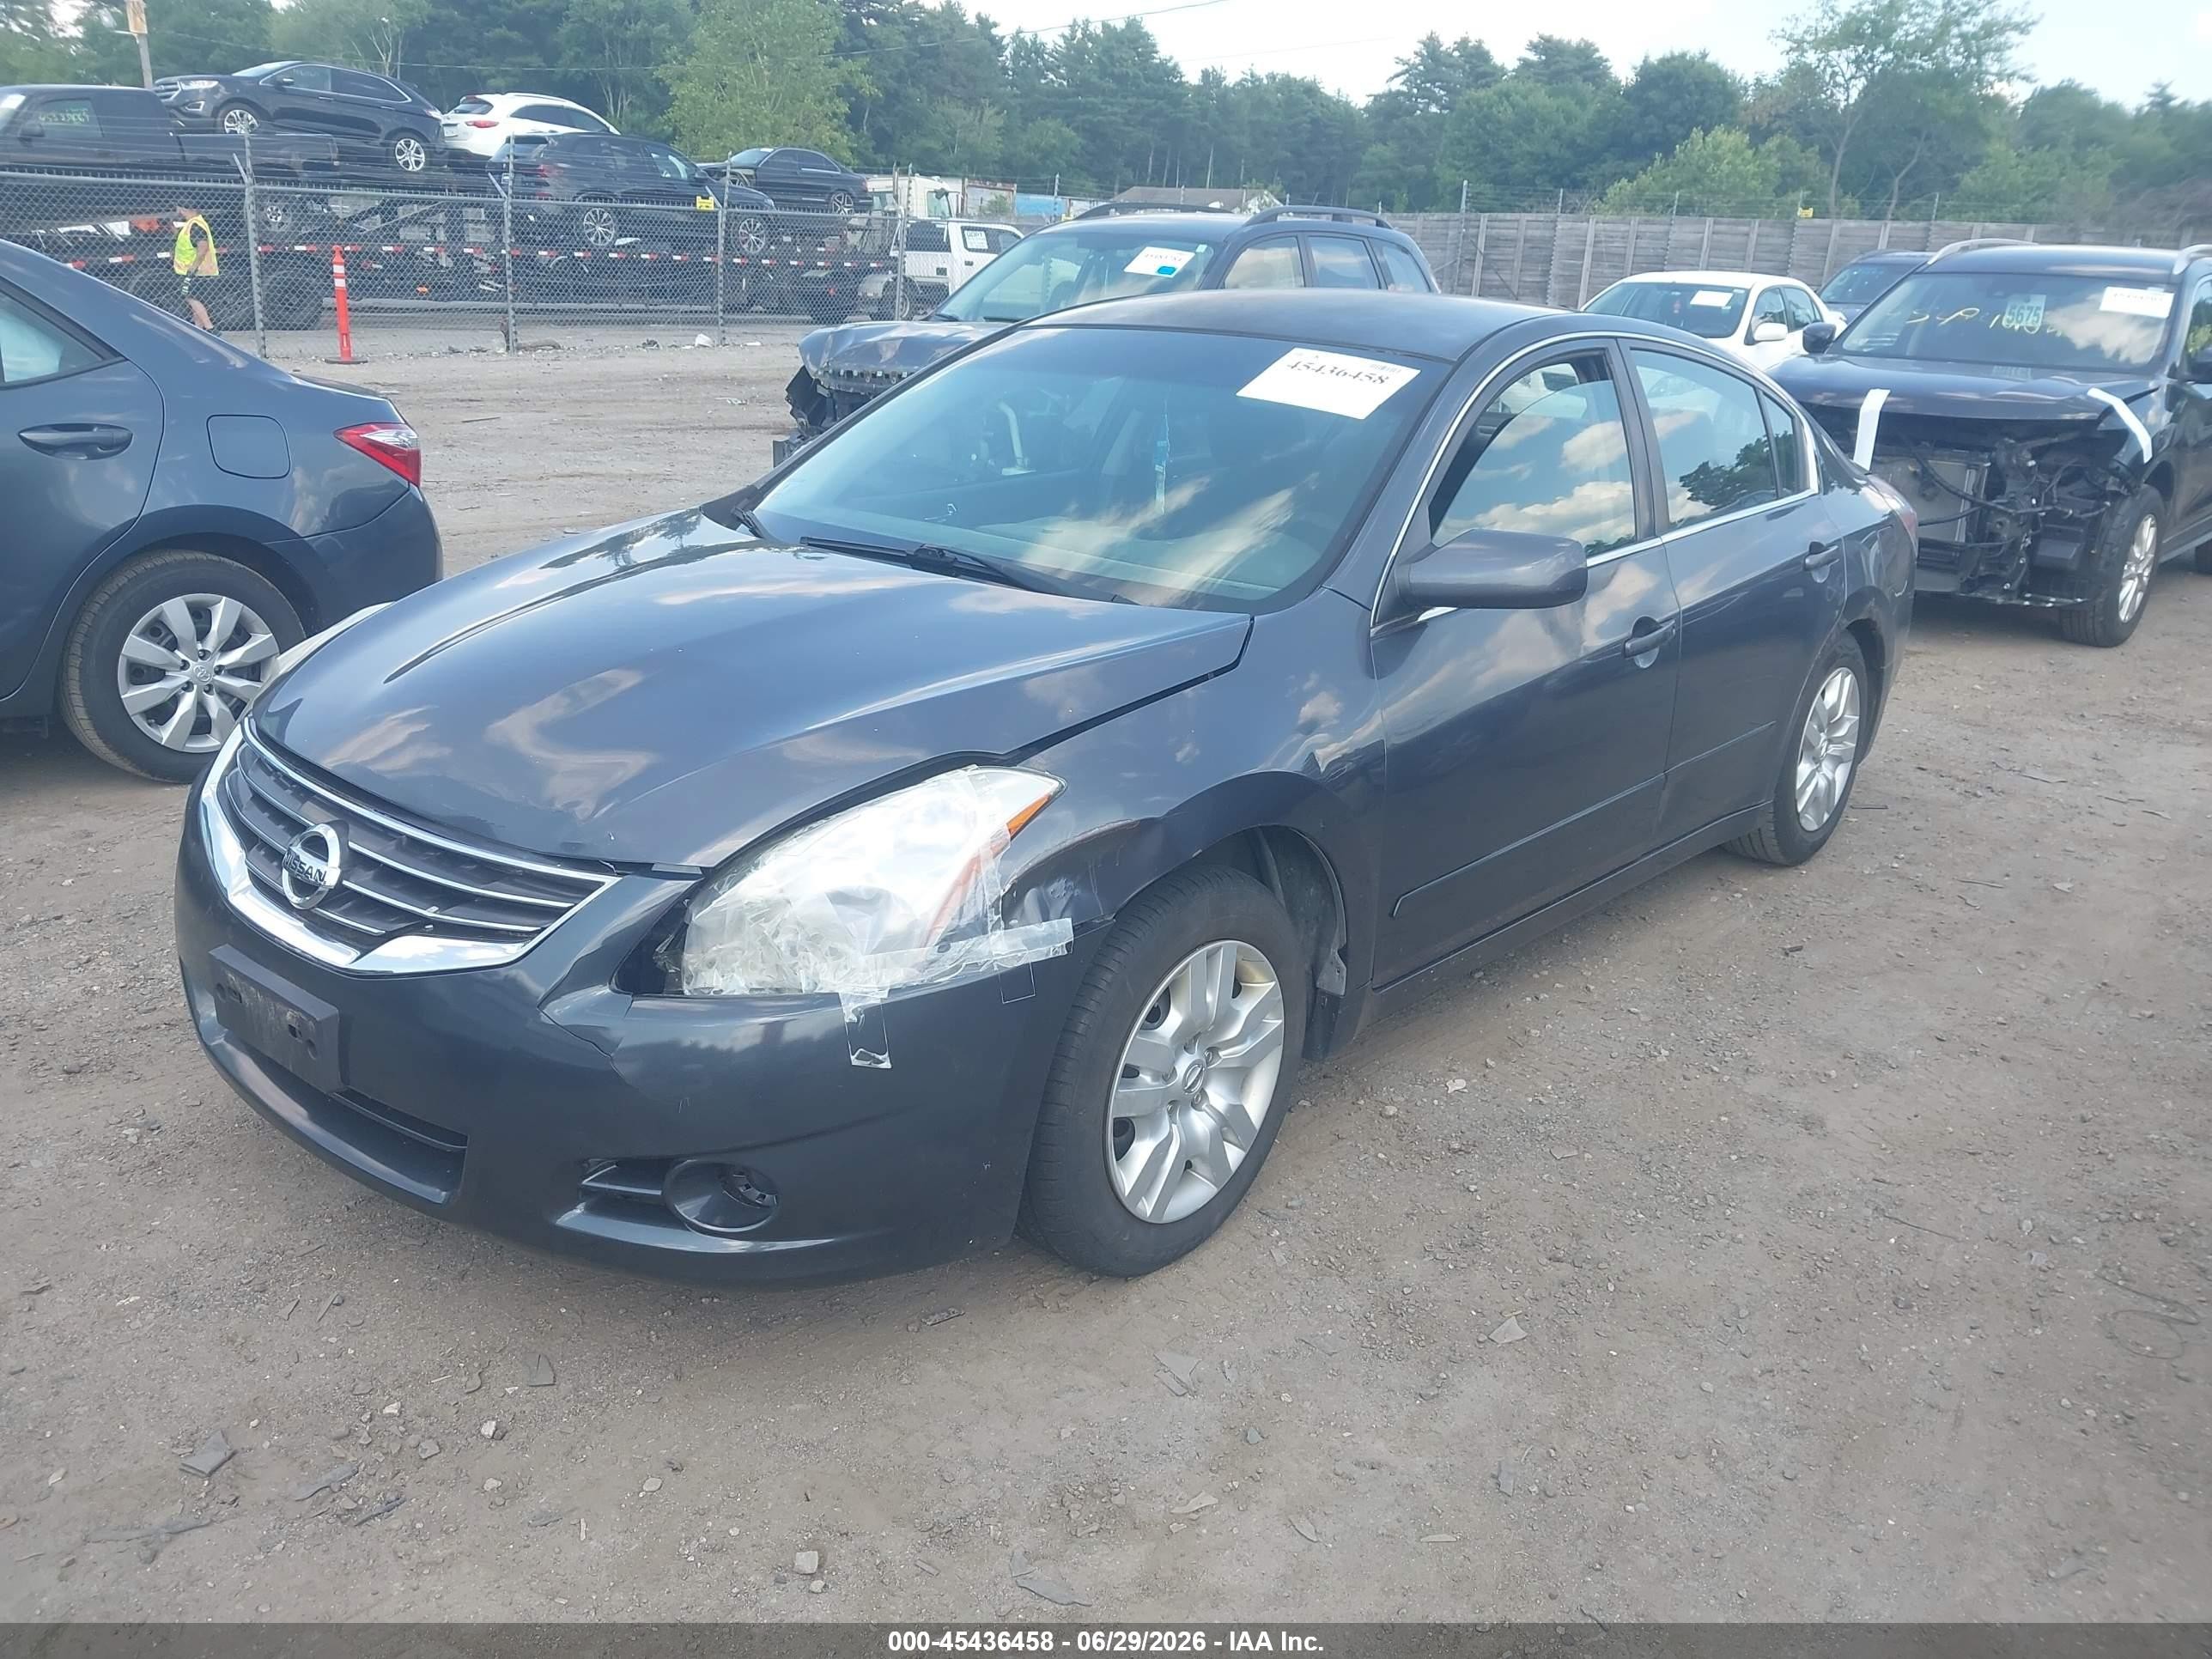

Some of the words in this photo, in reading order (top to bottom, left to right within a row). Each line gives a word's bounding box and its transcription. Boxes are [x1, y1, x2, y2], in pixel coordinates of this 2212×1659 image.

[2006, 305, 2042, 324] 5675
[1287, 361, 1389, 384] 45436458
[283, 850, 327, 883] NISSAN
